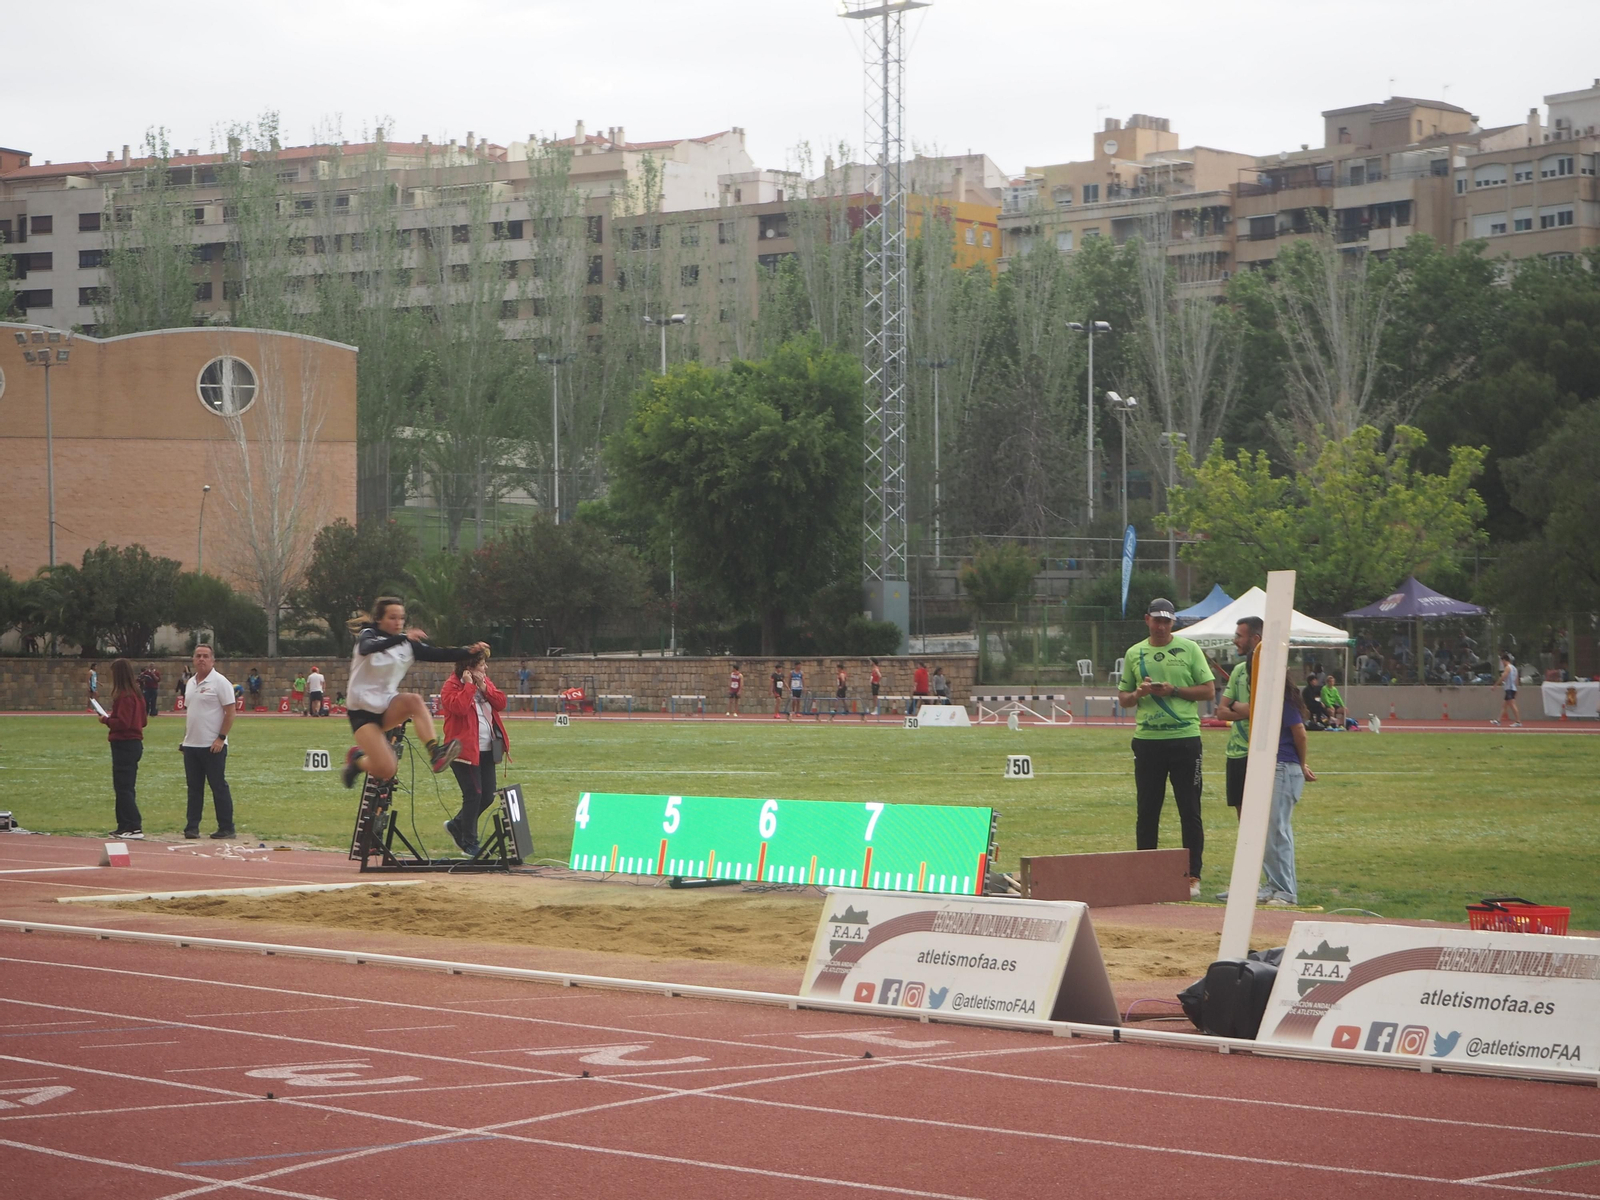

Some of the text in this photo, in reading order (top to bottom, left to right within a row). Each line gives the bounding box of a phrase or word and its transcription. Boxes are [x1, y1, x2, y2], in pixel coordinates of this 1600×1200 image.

[177, 700, 184, 709] 8
[237, 701, 243, 709] 7
[281, 701, 288, 710] 6
[557, 715, 568, 726] 40
[907, 718, 919, 728] 50
[312, 752, 328, 769] 60
[1013, 758, 1030, 775] 50
[575, 792, 885, 841] 4 5 6 7
[917, 949, 1017, 972] atletismofaa.es
[1301, 962, 1344, 979] F.A.A.
[952, 992, 1036, 1014] @atletismoFAA
[1420, 989, 1556, 1015] atletismofaa.es
[1466, 1037, 1581, 1061] @atletismoFAA
